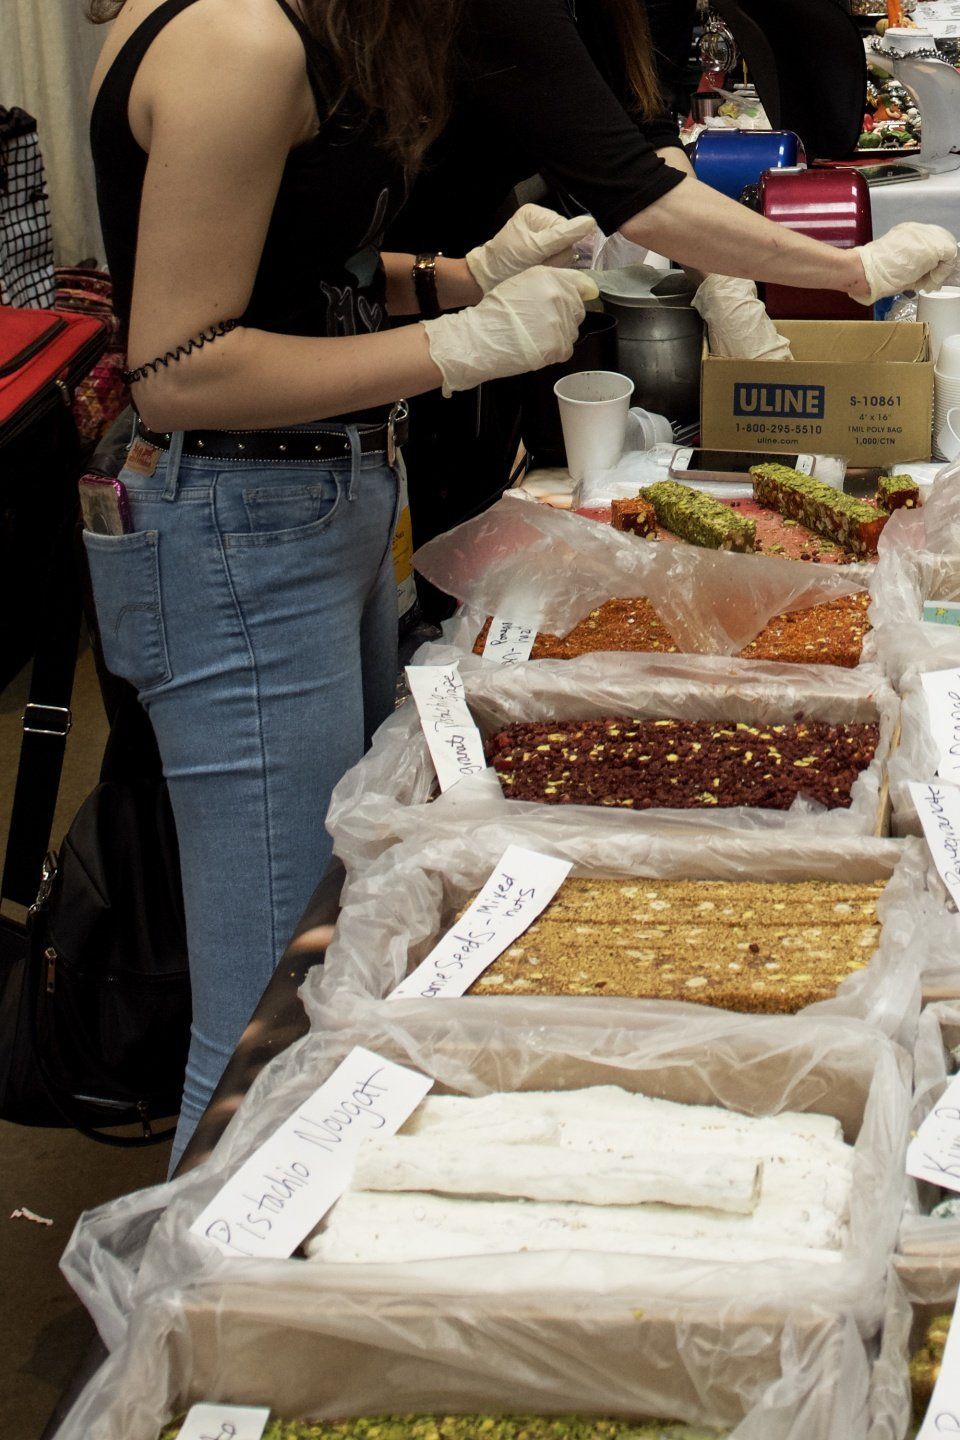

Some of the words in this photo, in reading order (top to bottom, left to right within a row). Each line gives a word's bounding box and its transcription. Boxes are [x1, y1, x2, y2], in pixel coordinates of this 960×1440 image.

[739, 387, 819, 415] ULINE
[849, 395, 902, 408] S-10861
[735, 422, 822, 435] 1-800-295-5510
[887, 426, 903, 434] BAG
[757, 437, 799, 445] uline.com
[435, 931, 496, 969] Seeds
[476, 873, 517, 915] Mixed
[205, 1161, 310, 1257] Pistachio
[293, 1068, 389, 1153] Nougat
